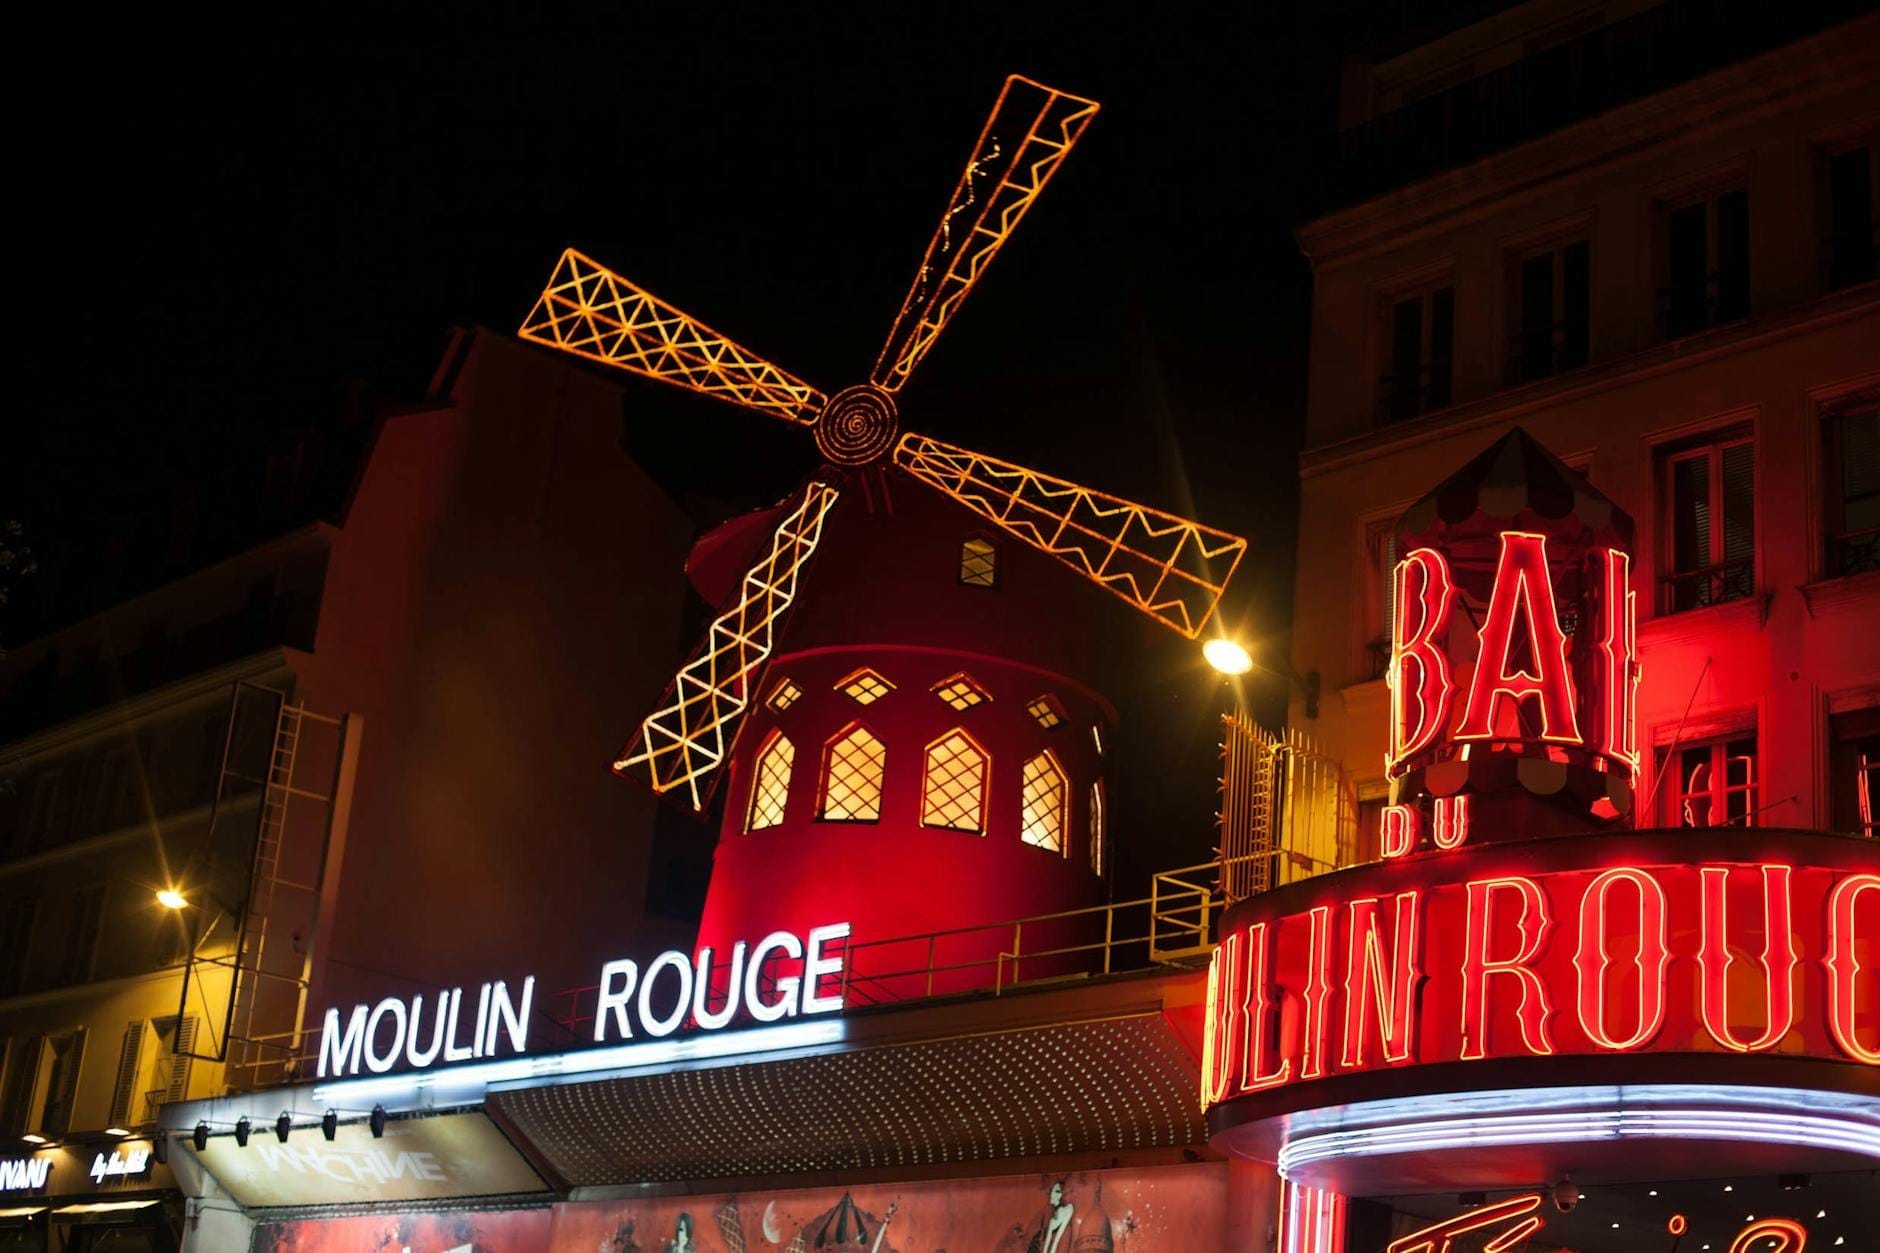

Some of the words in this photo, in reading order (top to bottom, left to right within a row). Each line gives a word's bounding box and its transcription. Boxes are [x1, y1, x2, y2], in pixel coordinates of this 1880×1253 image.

[1380, 796, 1466, 857] DU
[316, 975, 536, 1078] MOULIN
[593, 922, 851, 1042] ROUGE
